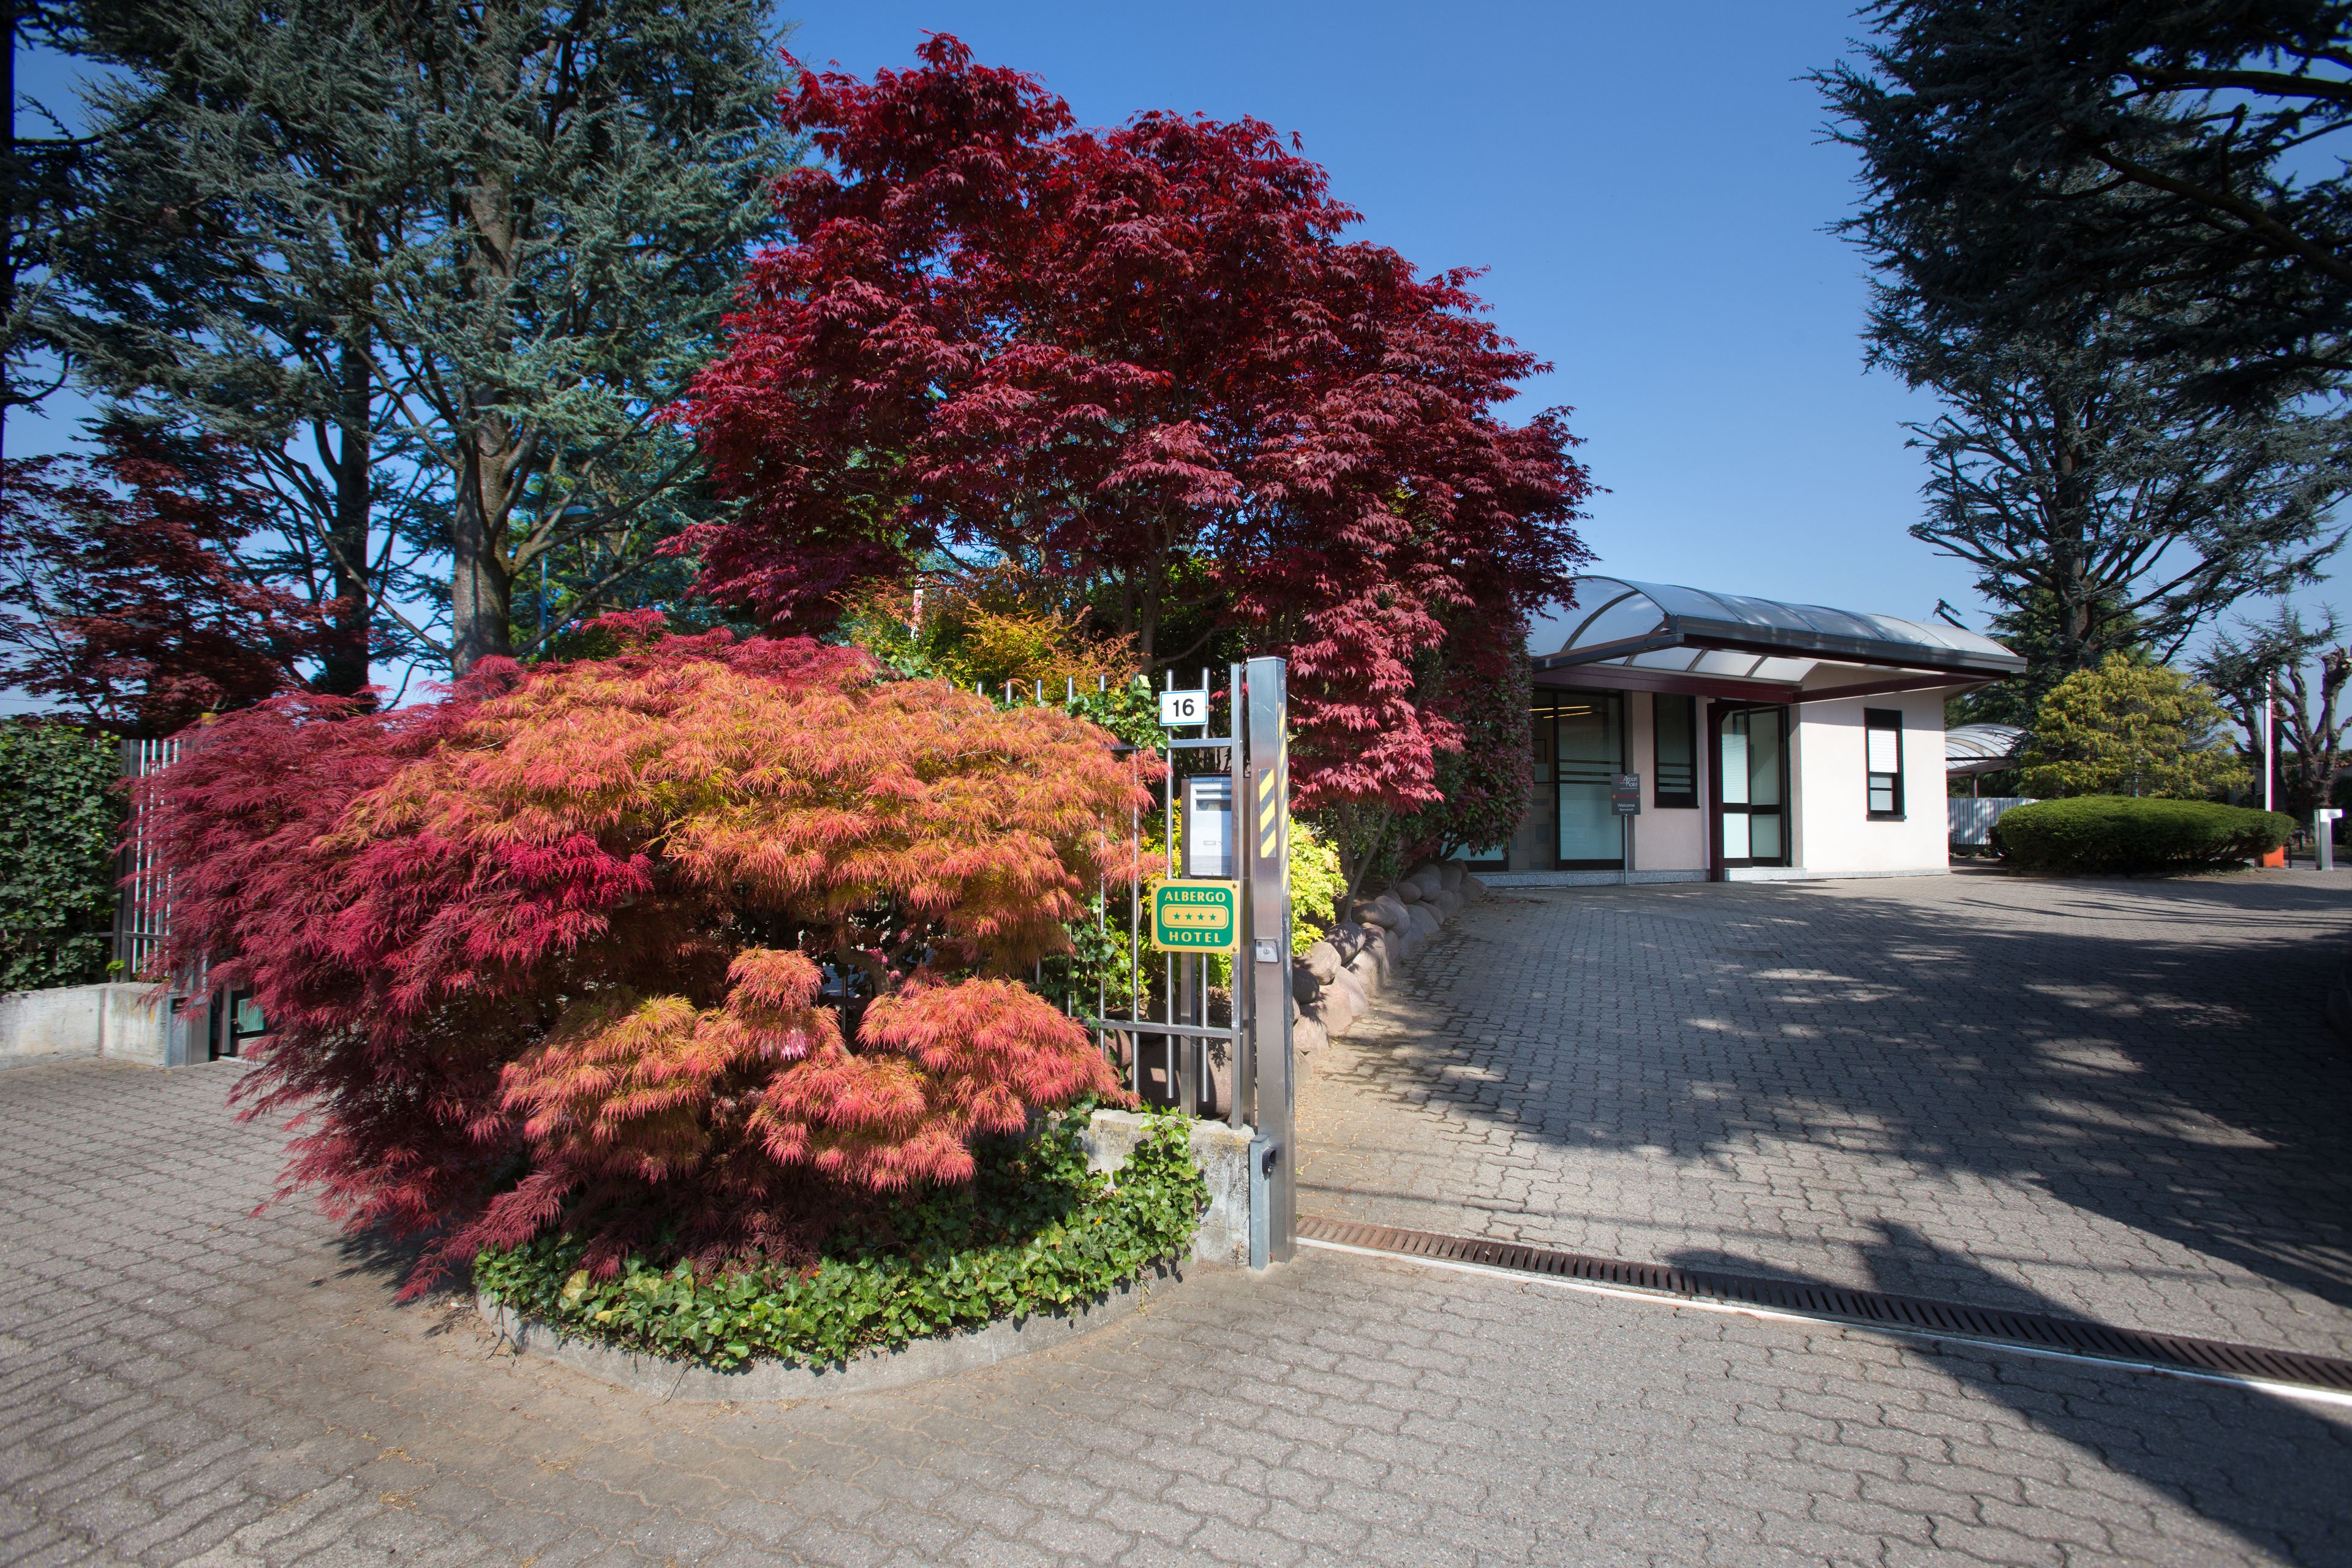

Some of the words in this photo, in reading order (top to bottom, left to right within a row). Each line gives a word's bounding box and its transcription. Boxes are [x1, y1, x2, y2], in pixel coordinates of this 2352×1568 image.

[1173, 698, 1194, 717] 16
[1164, 891, 1226, 902] ALBERGO
[1169, 931, 1221, 943] HOTEL
